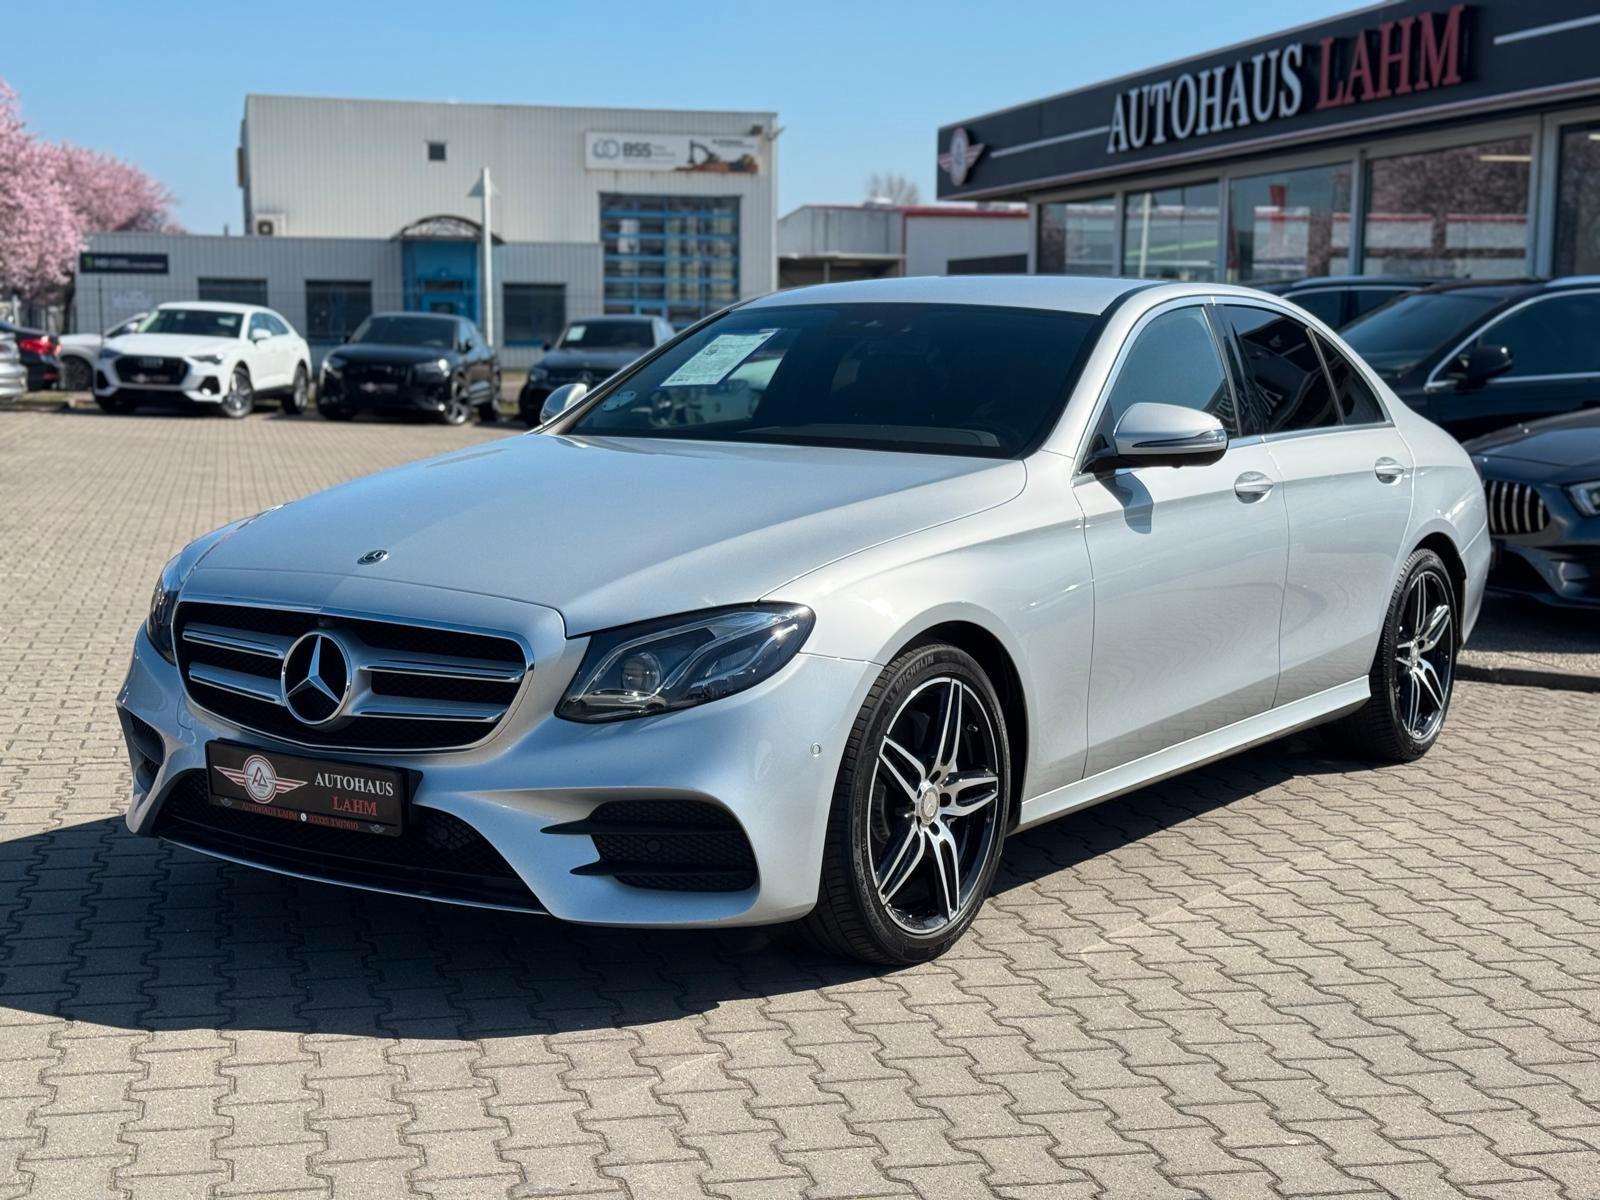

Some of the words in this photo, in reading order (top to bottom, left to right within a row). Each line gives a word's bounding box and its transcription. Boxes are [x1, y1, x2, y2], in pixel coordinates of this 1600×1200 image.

[1106, 43, 1303, 154] AUTOHAUS
[1315, 4, 1465, 111] LAHM
[622, 141, 652, 158] BSS
[895, 654, 935, 693] MICHELIN
[314, 772, 394, 797] AUTOHAUS
[332, 795, 378, 816] LAHM
